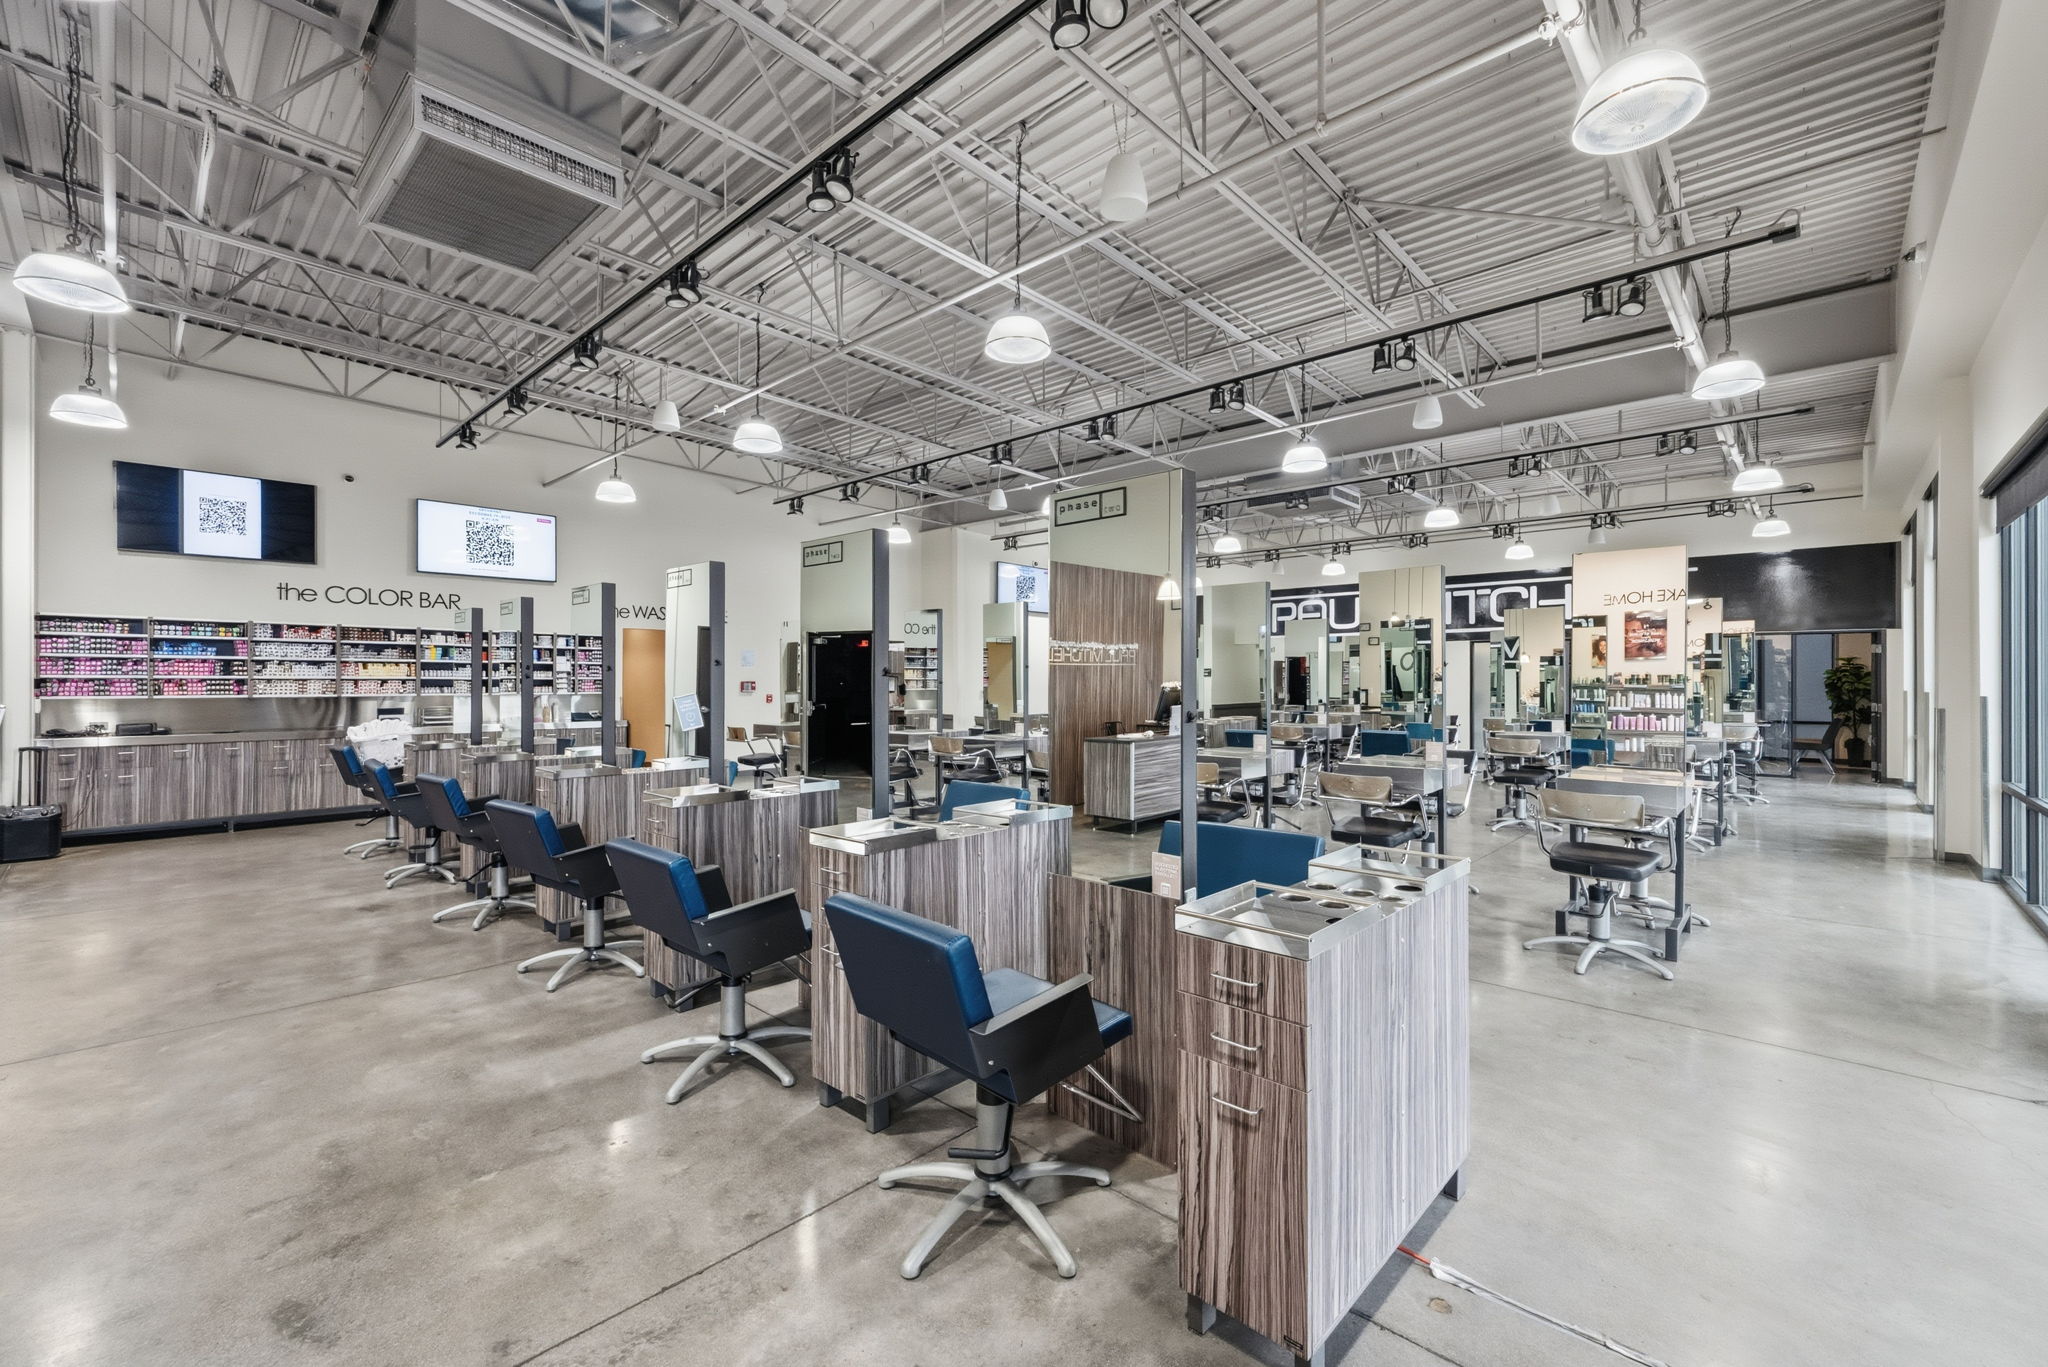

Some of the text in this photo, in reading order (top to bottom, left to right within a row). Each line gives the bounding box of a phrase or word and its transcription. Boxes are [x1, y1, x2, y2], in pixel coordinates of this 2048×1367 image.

[1060, 500, 1098, 515] phase
[276, 582, 461, 610] the COLOR BAR
